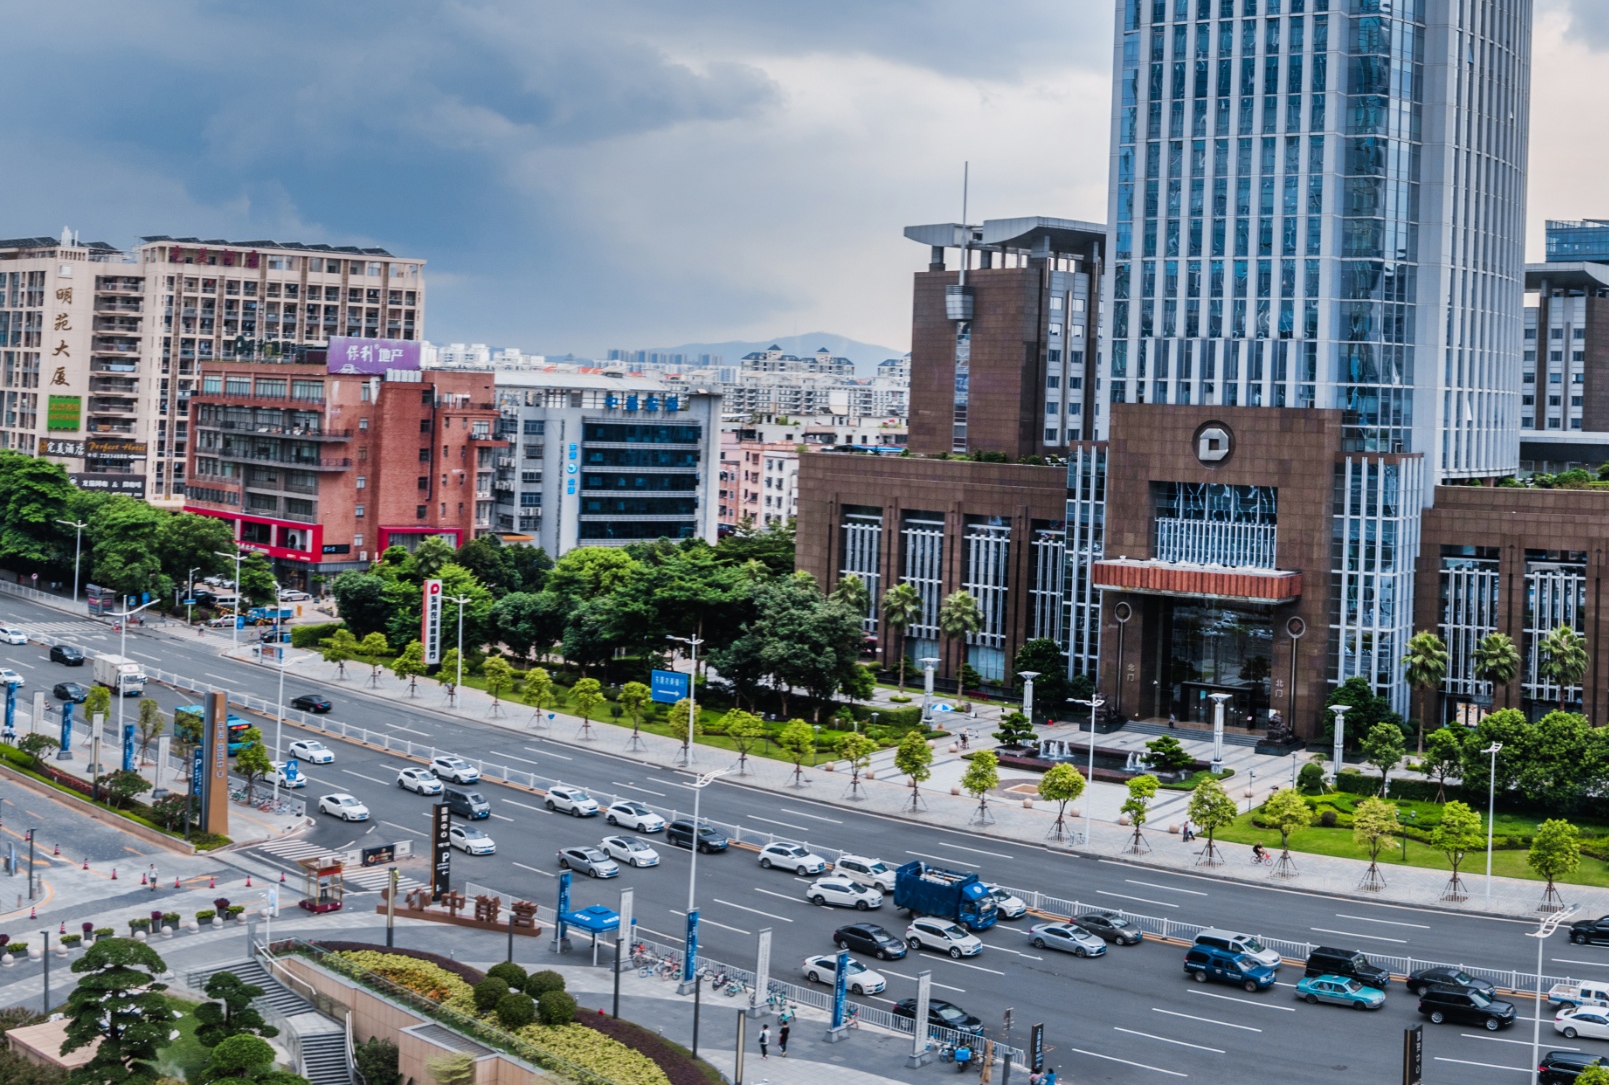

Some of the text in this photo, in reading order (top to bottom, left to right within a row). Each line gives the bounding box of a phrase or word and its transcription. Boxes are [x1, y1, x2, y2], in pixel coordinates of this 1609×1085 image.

[50, 287, 73, 387] 明苑大厦
[46, 440, 85, 456] 完美酒店
[88, 441, 146, 452] Perfect Hotel
[1127, 663, 1135, 682] 北门
[1274, 678, 1284, 698] 北门
[442, 851, 450, 862] P
